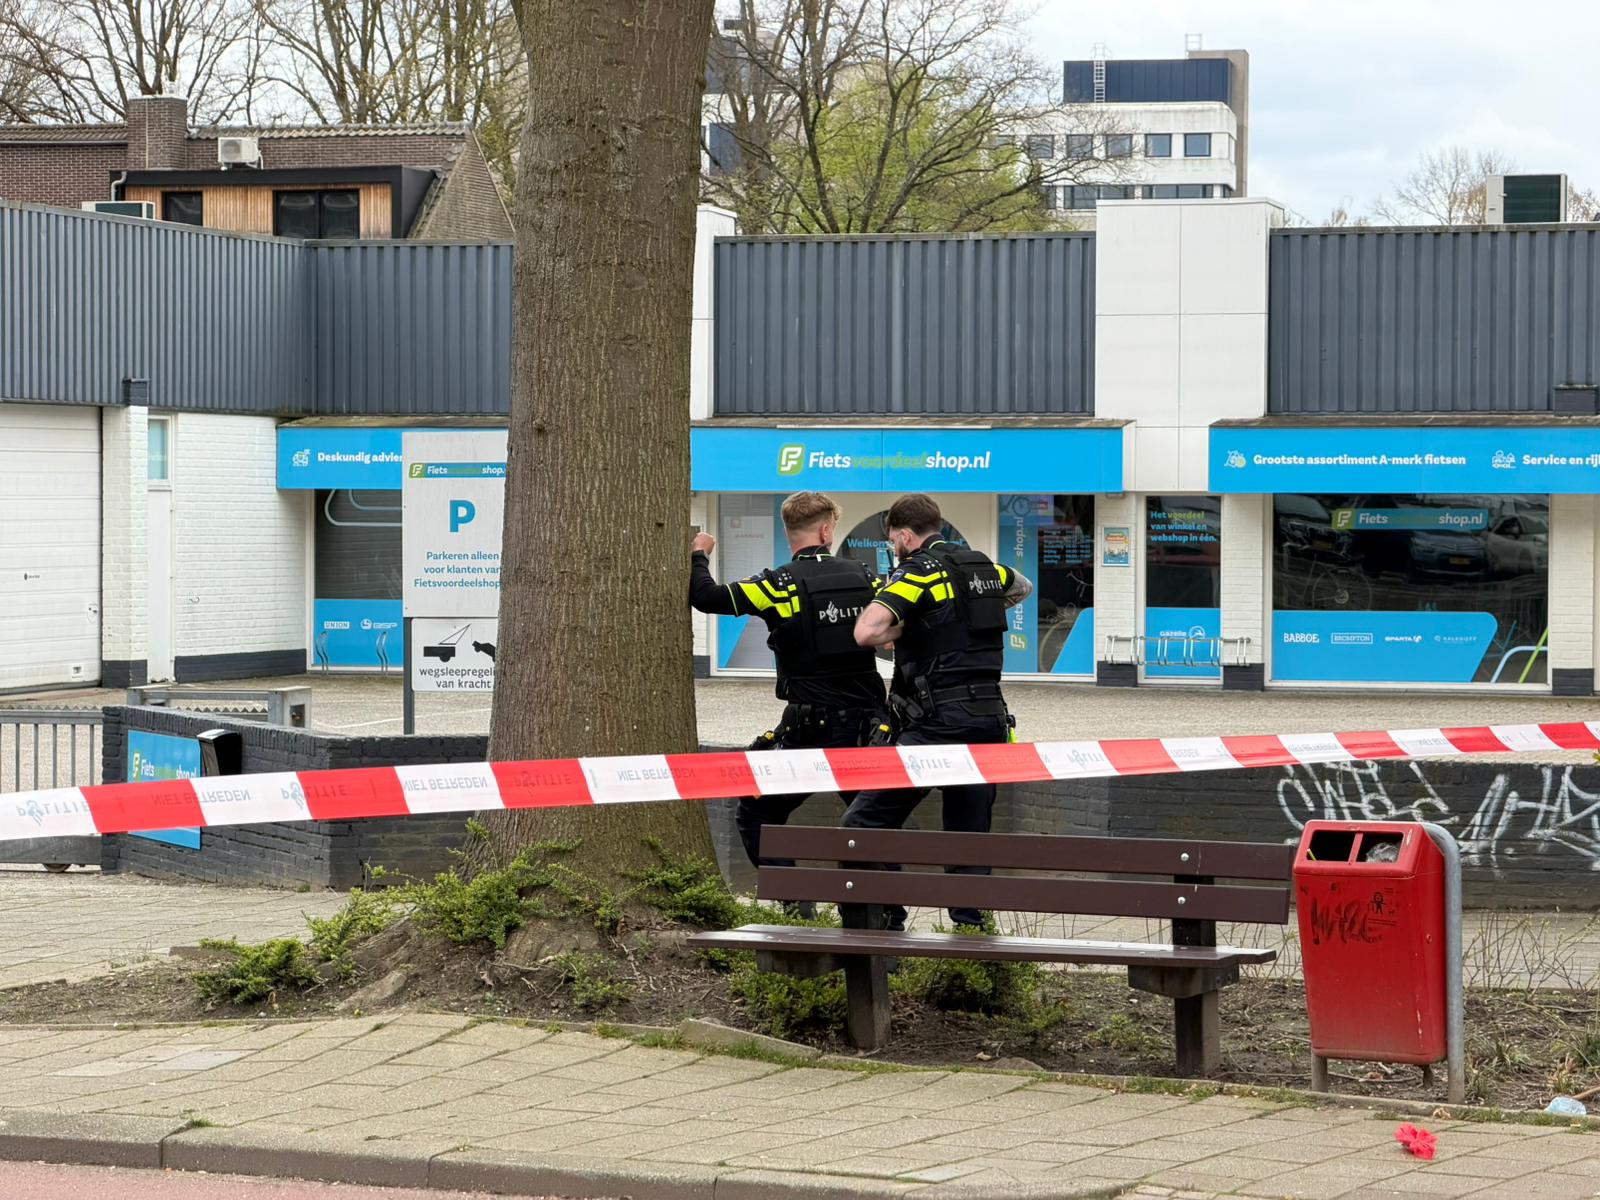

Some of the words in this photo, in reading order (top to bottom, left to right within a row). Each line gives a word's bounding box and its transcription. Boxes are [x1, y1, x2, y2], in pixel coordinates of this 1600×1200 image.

[317, 452, 371, 465] Deskundig
[1253, 454, 1305, 465] Grootste
[1307, 454, 1378, 465] assortiment
[1379, 454, 1423, 465] A-merk
[1424, 454, 1466, 465] fietsen
[1522, 454, 1567, 465] Service
[1568, 457, 1583, 465] en
[427, 466, 448, 474] Fiets
[449, 500, 476, 533] P
[1151, 511, 1167, 519] Het
[1168, 511, 1205, 519] voordeel
[1358, 513, 1388, 524] Fiets
[1438, 512, 1483, 528] shop.nl
[1168, 522, 1195, 530] winkel
[1151, 533, 1188, 543] webshop
[1190, 533, 1197, 542] in
[426, 551, 469, 560] Parkeren
[471, 551, 500, 560] alleen
[424, 566, 445, 574] voor
[447, 565, 482, 574] klanten
[969, 573, 1003, 594] POLITIE
[819, 601, 864, 623] POLITI
[1284, 633, 1319, 643] BABBOE
[436, 681, 454, 689] van
[458, 679, 492, 689] kracht
